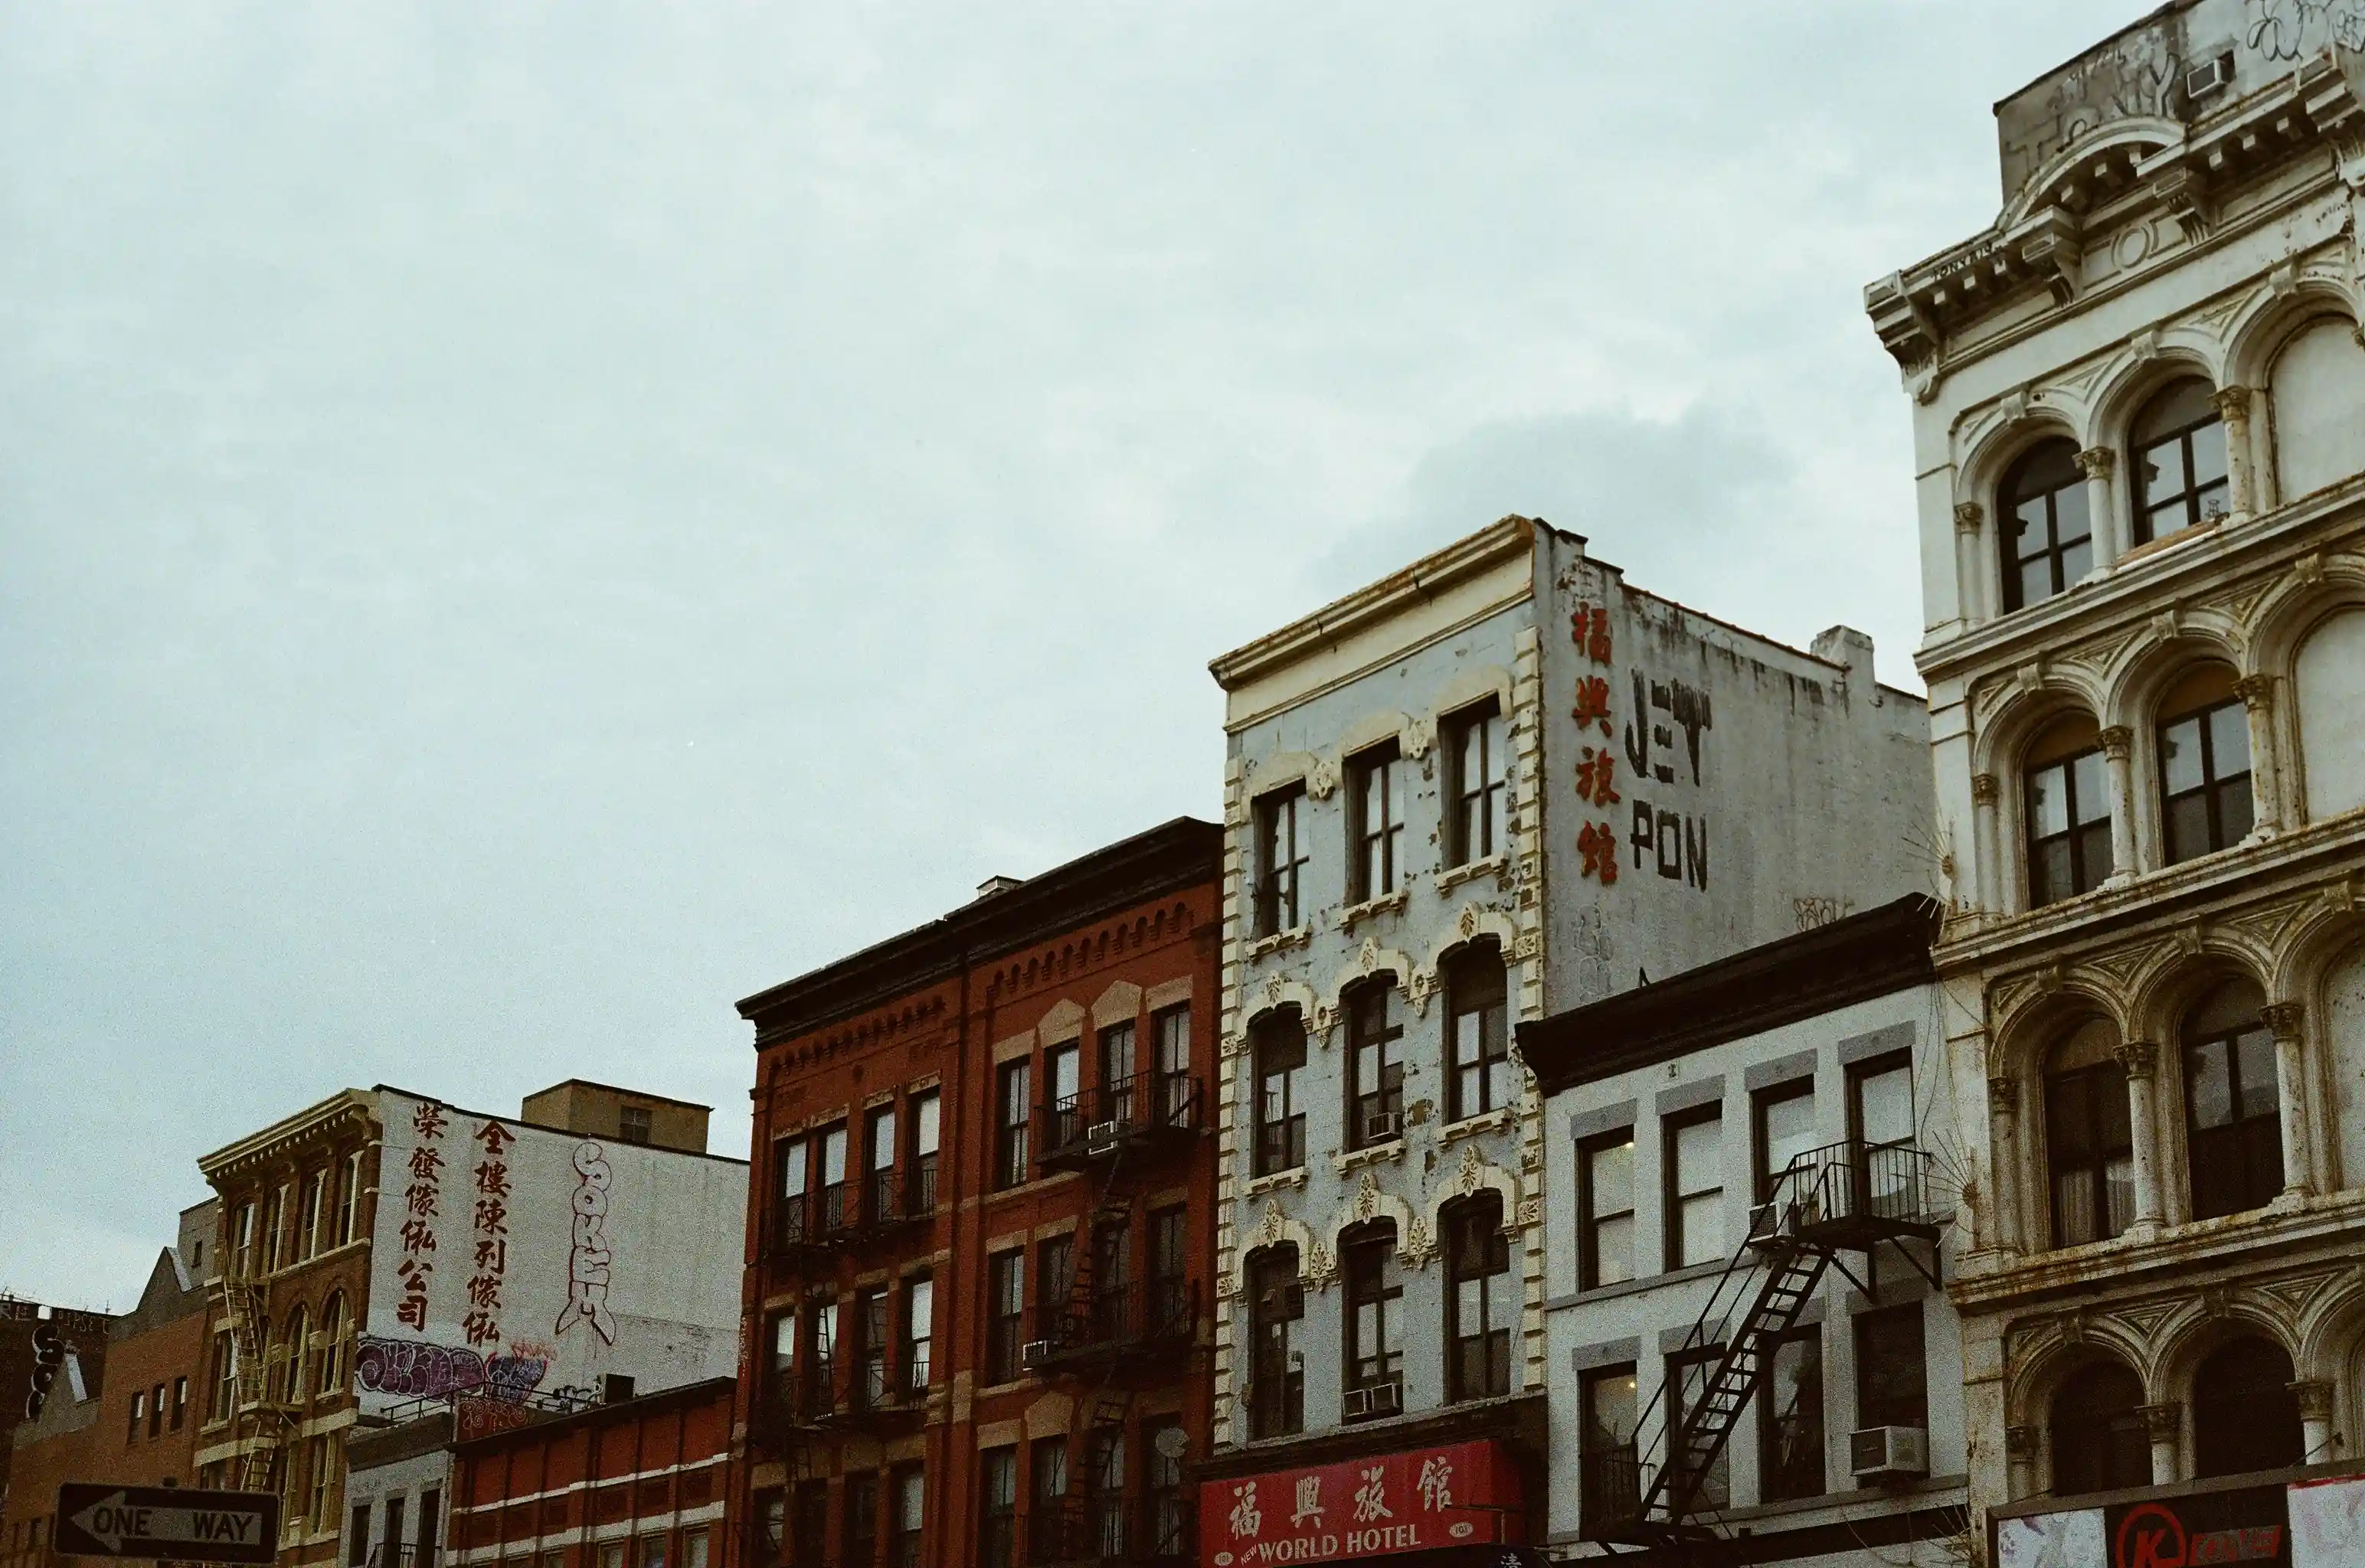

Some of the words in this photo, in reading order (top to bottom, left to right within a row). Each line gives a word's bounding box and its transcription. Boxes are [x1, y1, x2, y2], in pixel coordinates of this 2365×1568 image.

[1228, 1456, 1454, 1540] 福興旅館
[93, 1506, 152, 1537] ONE
[192, 1512, 253, 1541] WAY
[1240, 1544, 1258, 1566] NEW
[1258, 1536, 1339, 1563] WORLD
[1346, 1524, 1421, 1551] HOTEL
